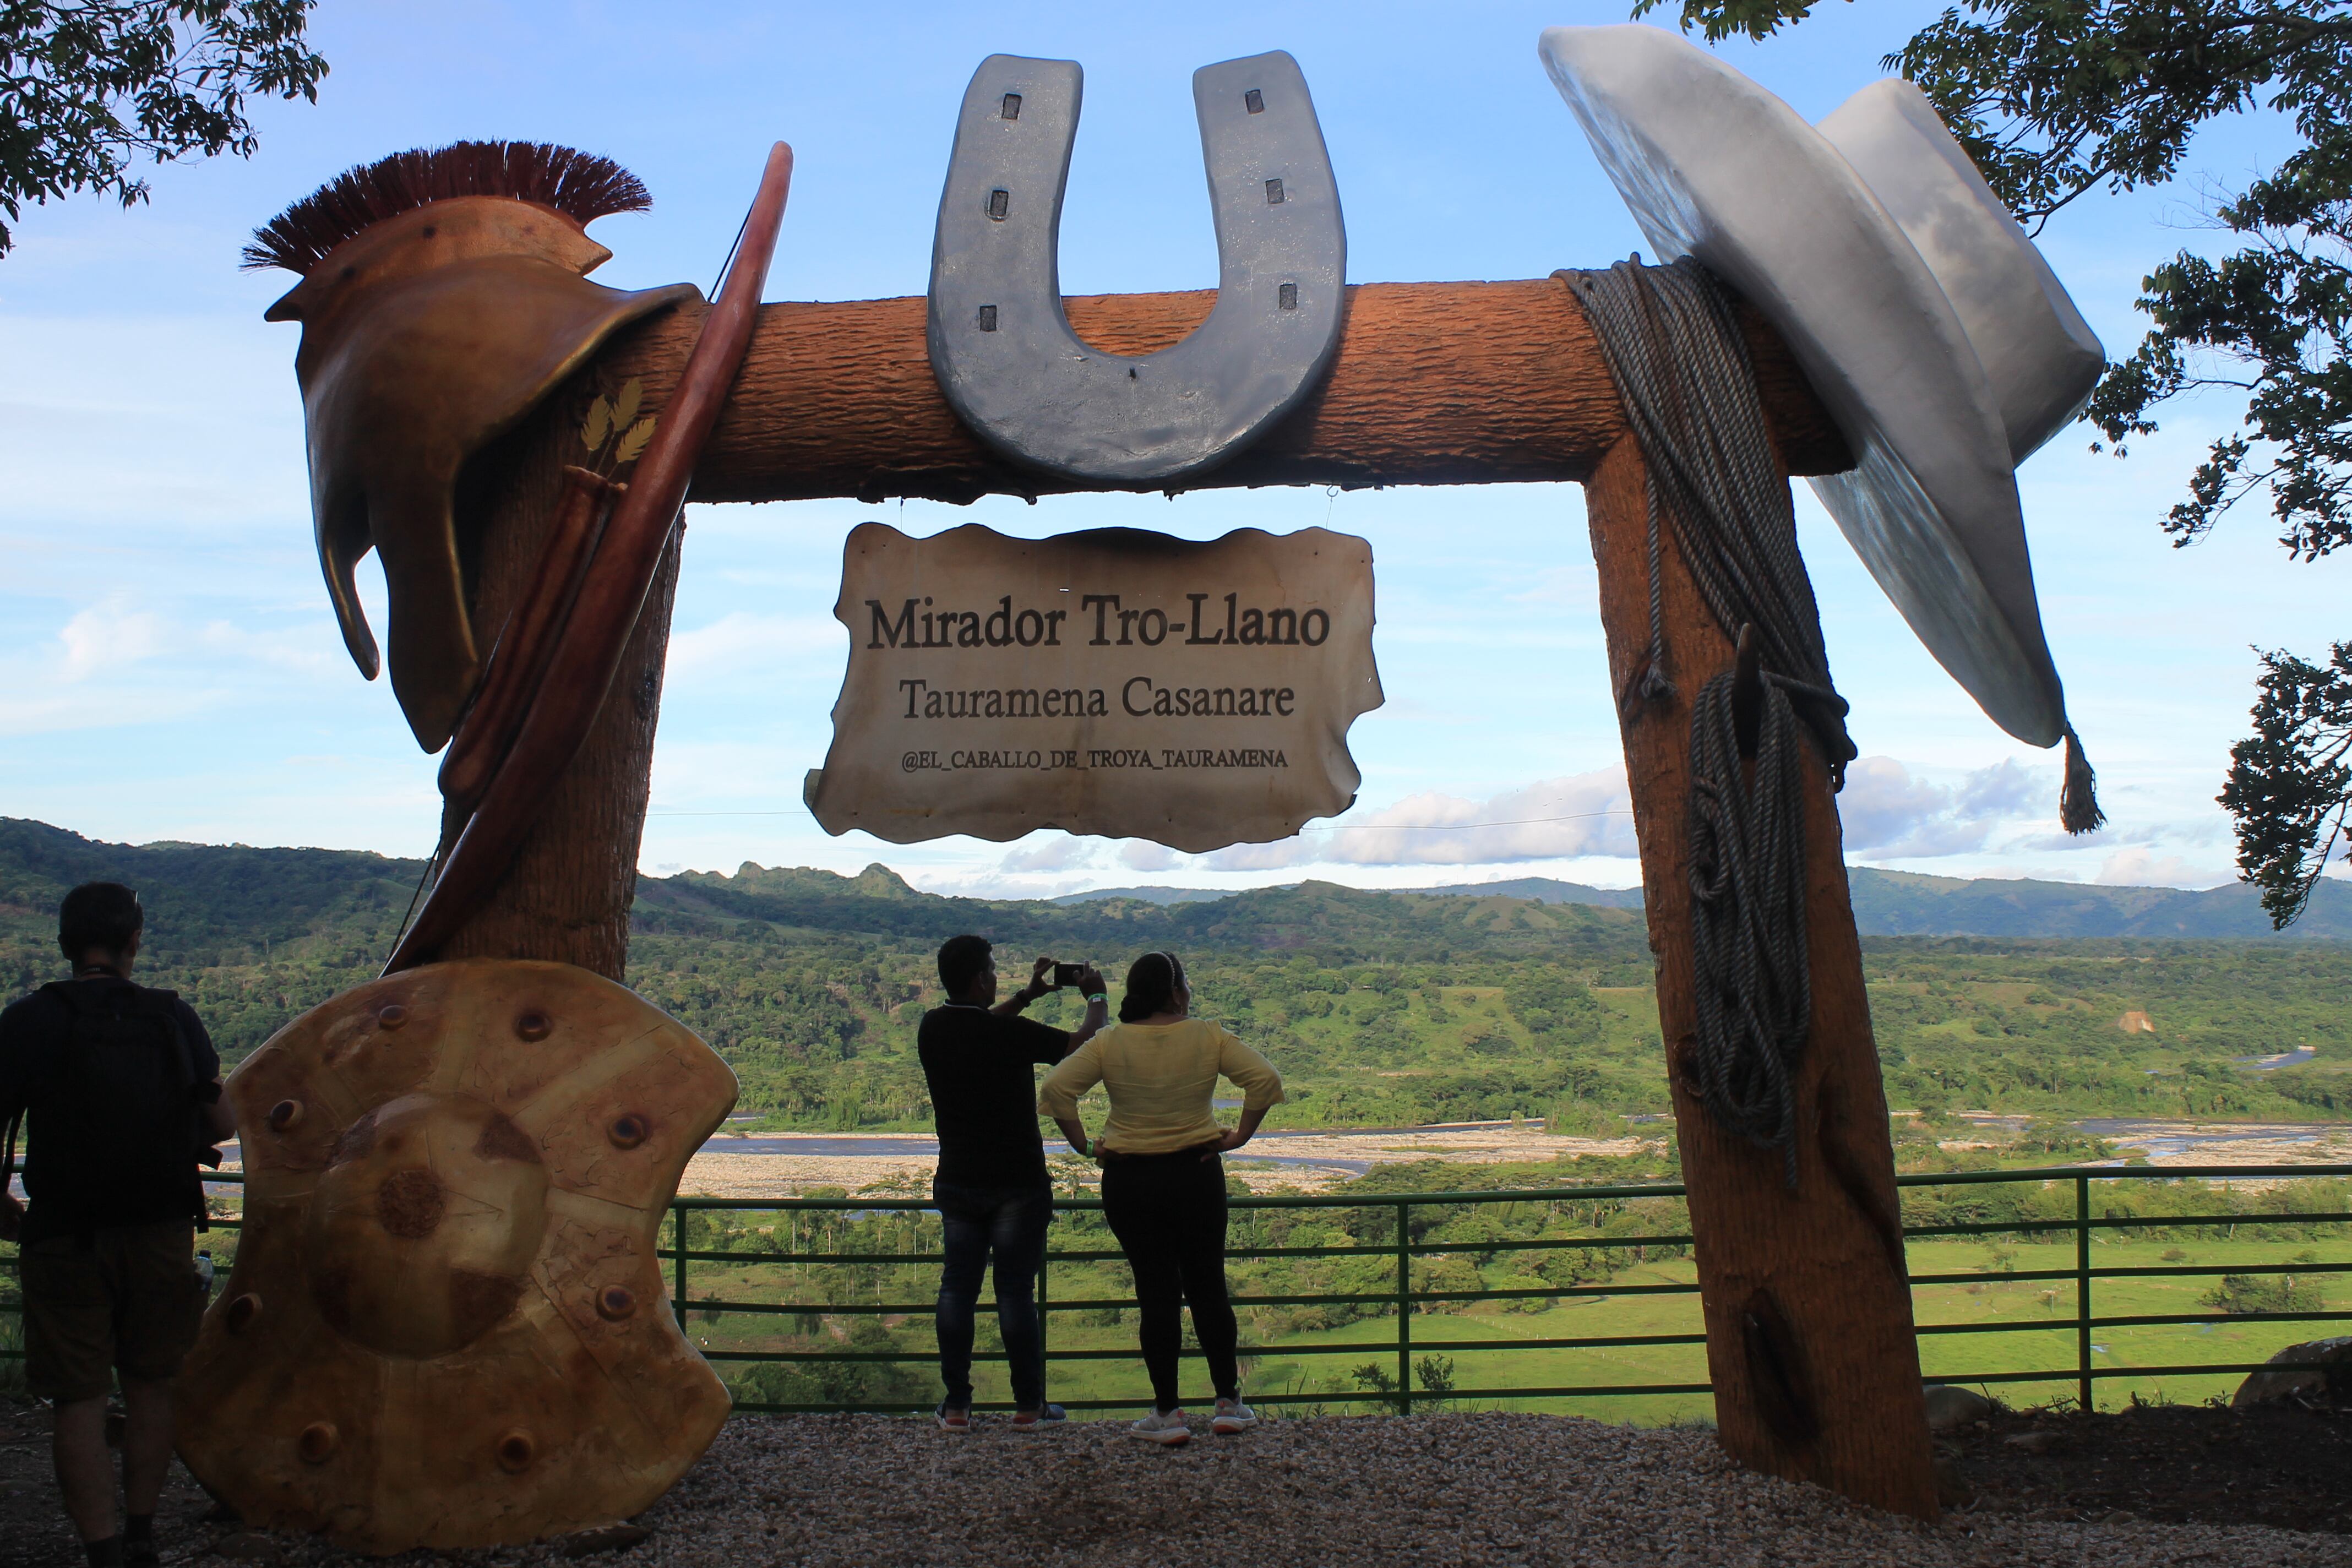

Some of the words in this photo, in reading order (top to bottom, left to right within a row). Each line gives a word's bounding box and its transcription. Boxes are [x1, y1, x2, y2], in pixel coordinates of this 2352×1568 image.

[866, 595, 1066, 650] Mirador
[1081, 592, 1330, 646] Tro-Llano
[900, 679, 1108, 719] Tauramena
[1123, 677, 1294, 717] Casanare
[902, 750, 1288, 772] @EL_CABALLO_DE_TROYA_TAURAMENA
